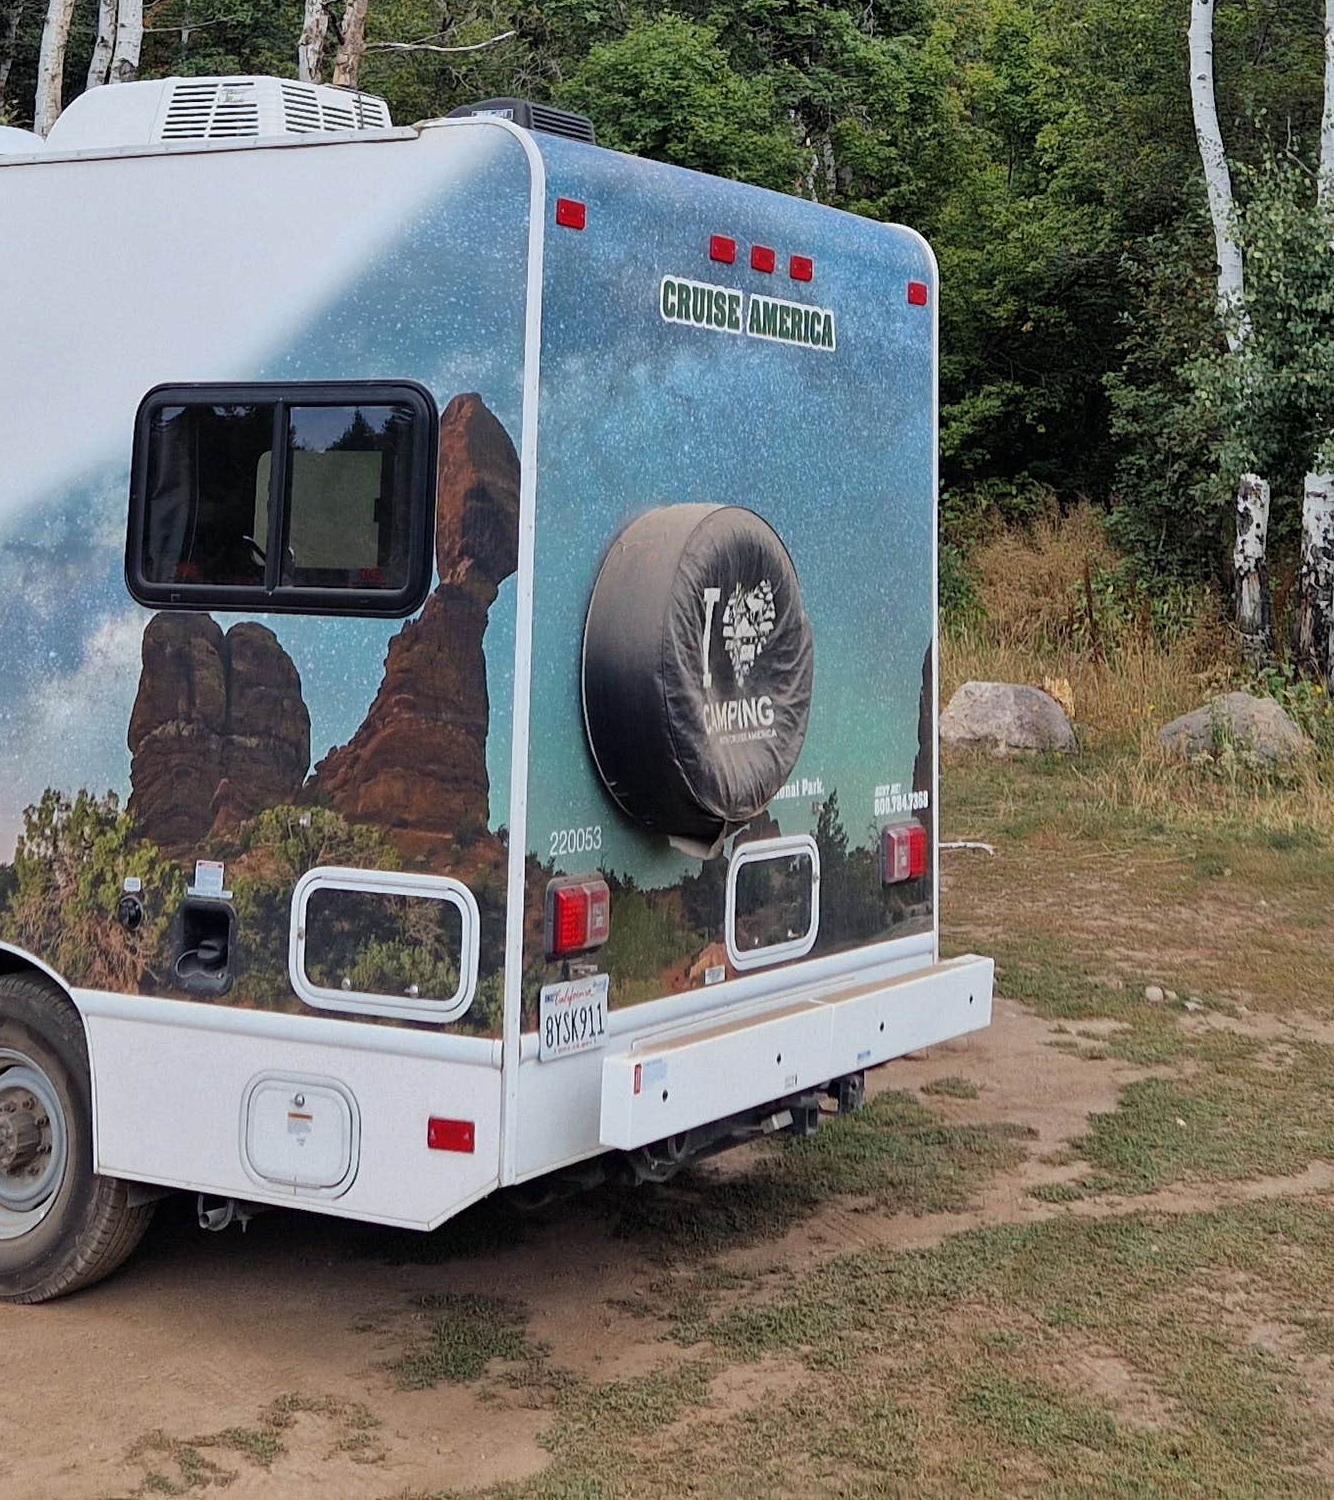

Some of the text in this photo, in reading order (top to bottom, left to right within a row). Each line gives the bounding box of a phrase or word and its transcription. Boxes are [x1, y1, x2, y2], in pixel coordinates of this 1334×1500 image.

[662, 279, 834, 348] CRUISE AMERICA
[703, 695, 774, 735] CAMPING
[549, 825, 602, 856] 220053
[546, 1002, 604, 1049] 8YSK911
